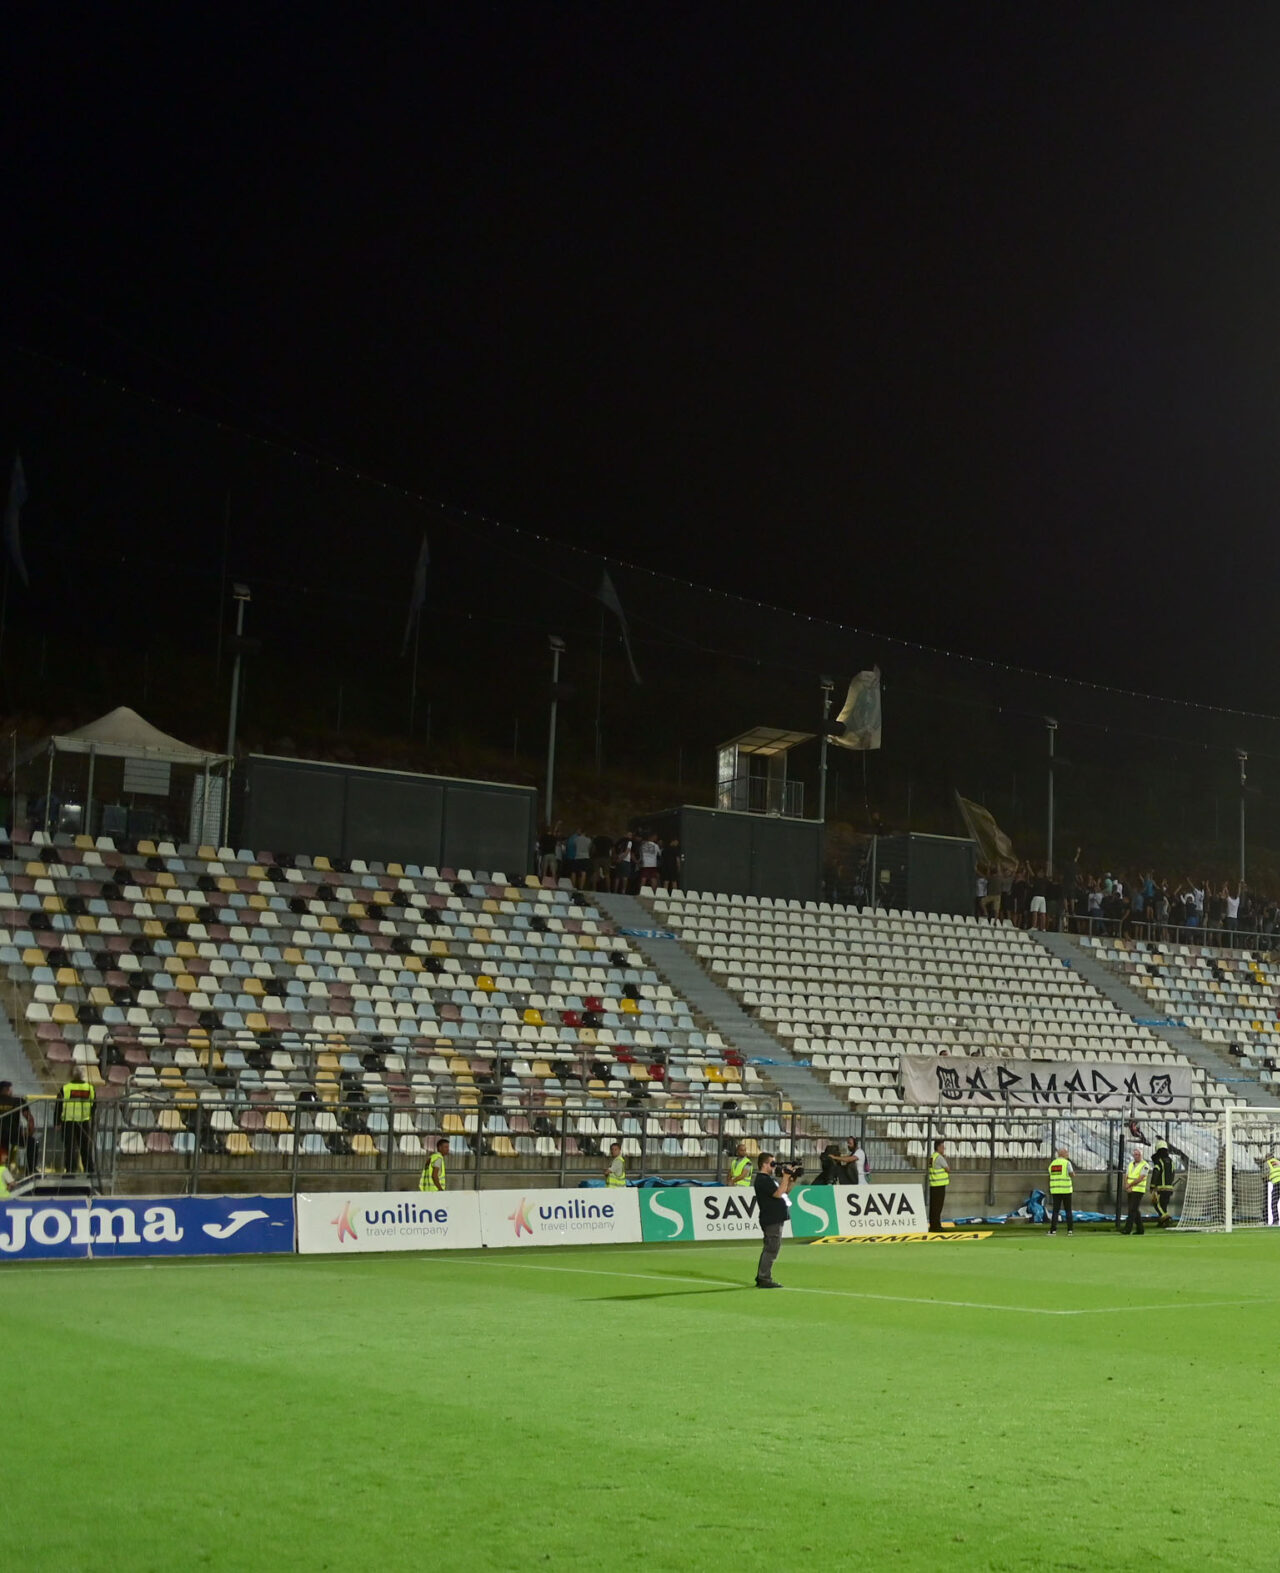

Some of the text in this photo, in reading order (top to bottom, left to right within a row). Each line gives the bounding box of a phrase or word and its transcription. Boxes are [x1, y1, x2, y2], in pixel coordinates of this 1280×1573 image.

[966, 1066, 1147, 1105] ARMADA
[365, 1203, 448, 1224] uniline
[539, 1199, 614, 1220] uniline
[704, 1195, 757, 1220] SAV
[846, 1192, 915, 1216] SAVA
[366, 1226, 449, 1237] travel company
[540, 1220, 615, 1232] travel company
[706, 1222, 759, 1231] OSIGURA
[850, 1218, 917, 1228] OSIGURANJE
